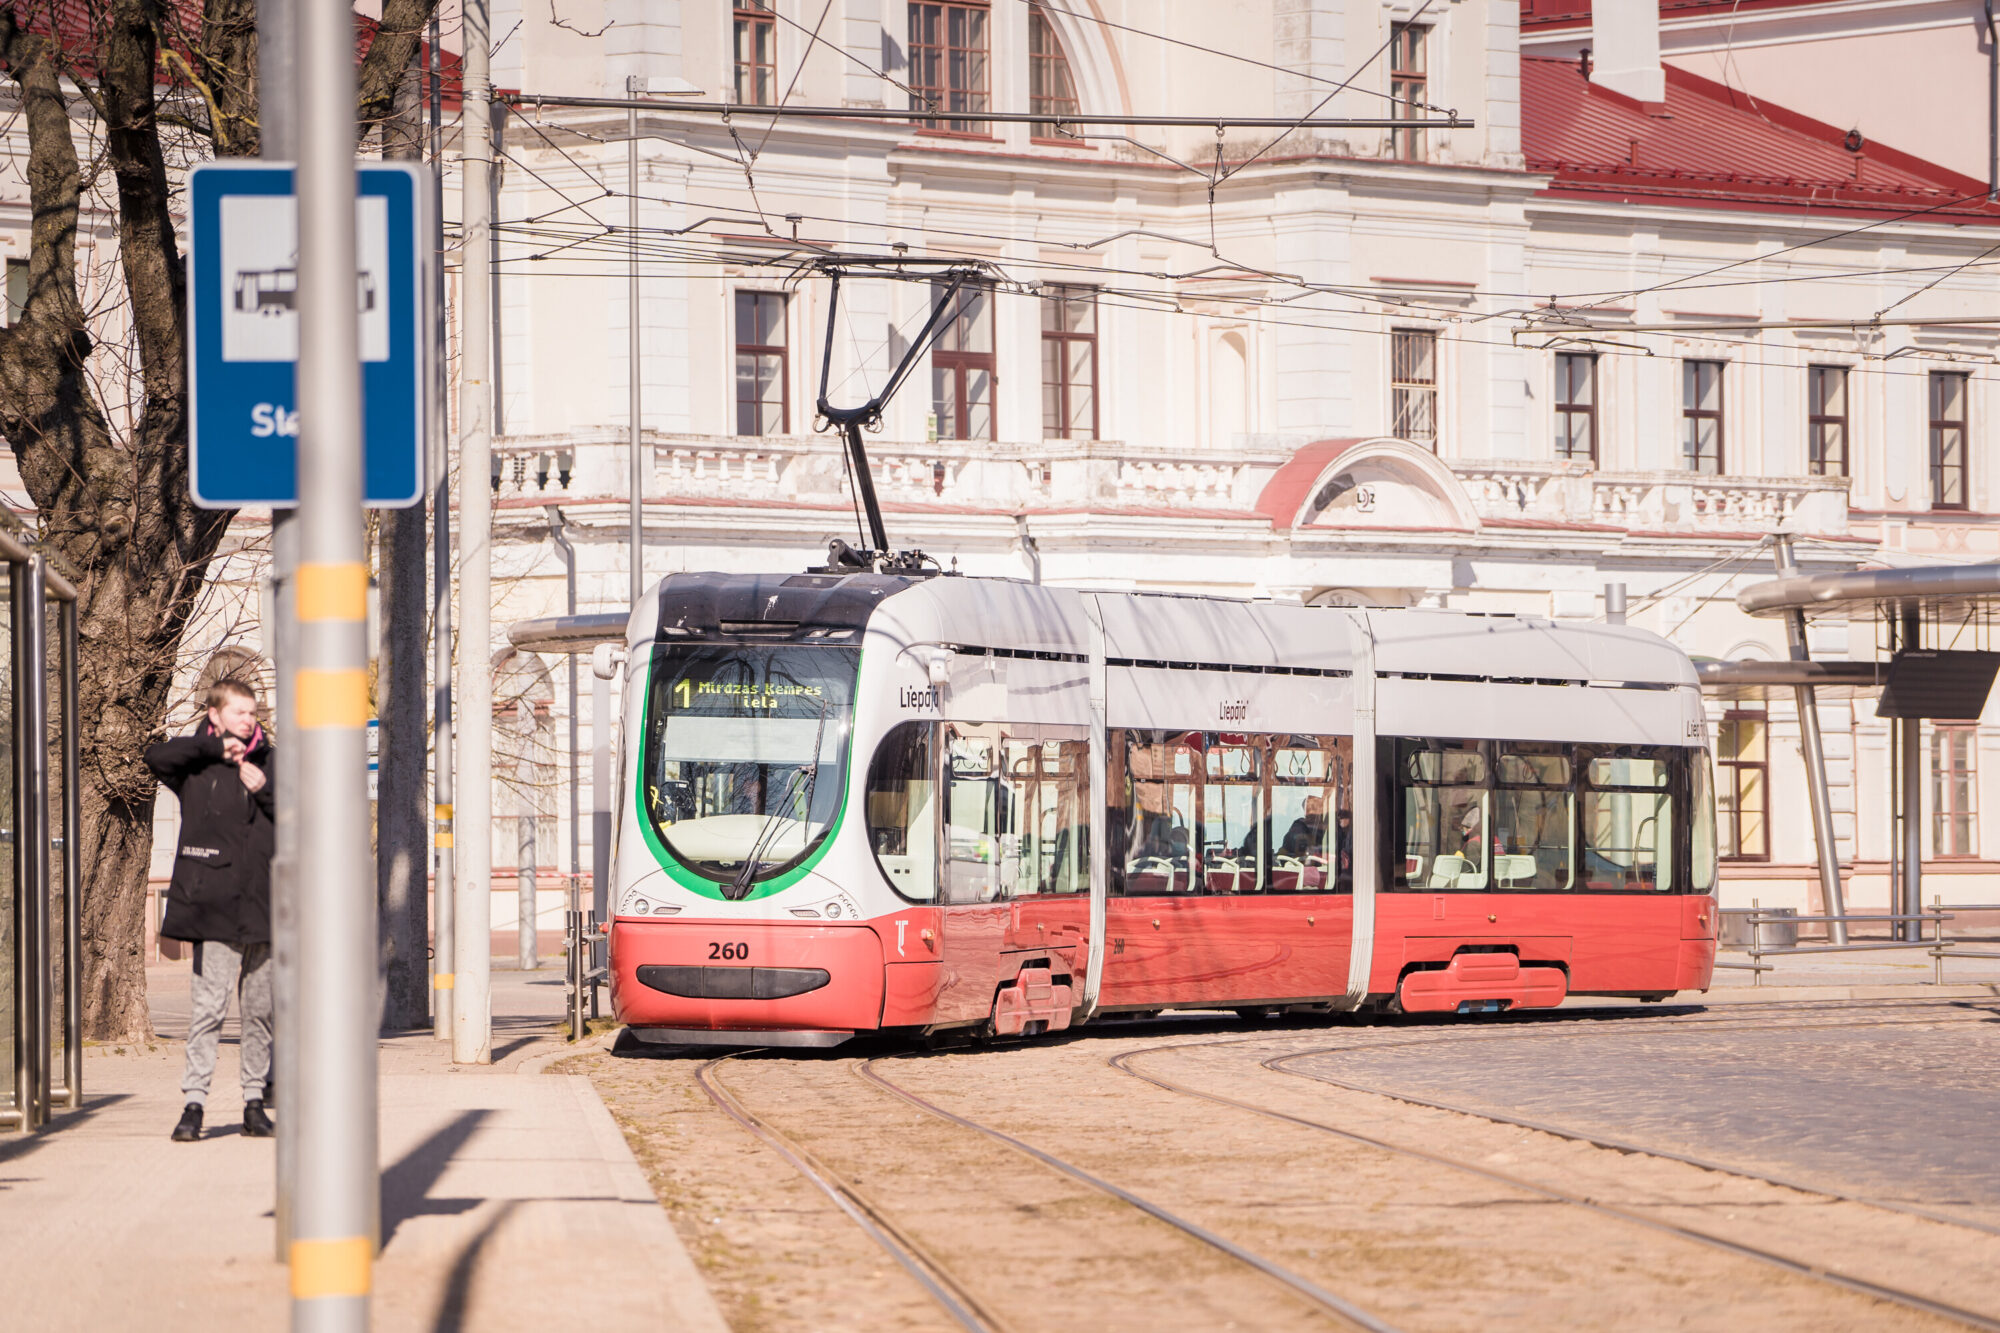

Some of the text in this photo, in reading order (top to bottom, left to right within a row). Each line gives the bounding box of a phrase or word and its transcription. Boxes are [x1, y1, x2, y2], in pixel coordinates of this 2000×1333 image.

[674, 678, 690, 709] 1
[698, 681, 759, 694] Mirdzas
[743, 696, 778, 709] iela
[708, 942, 749, 960] 260
[1113, 937, 1125, 955] 260
